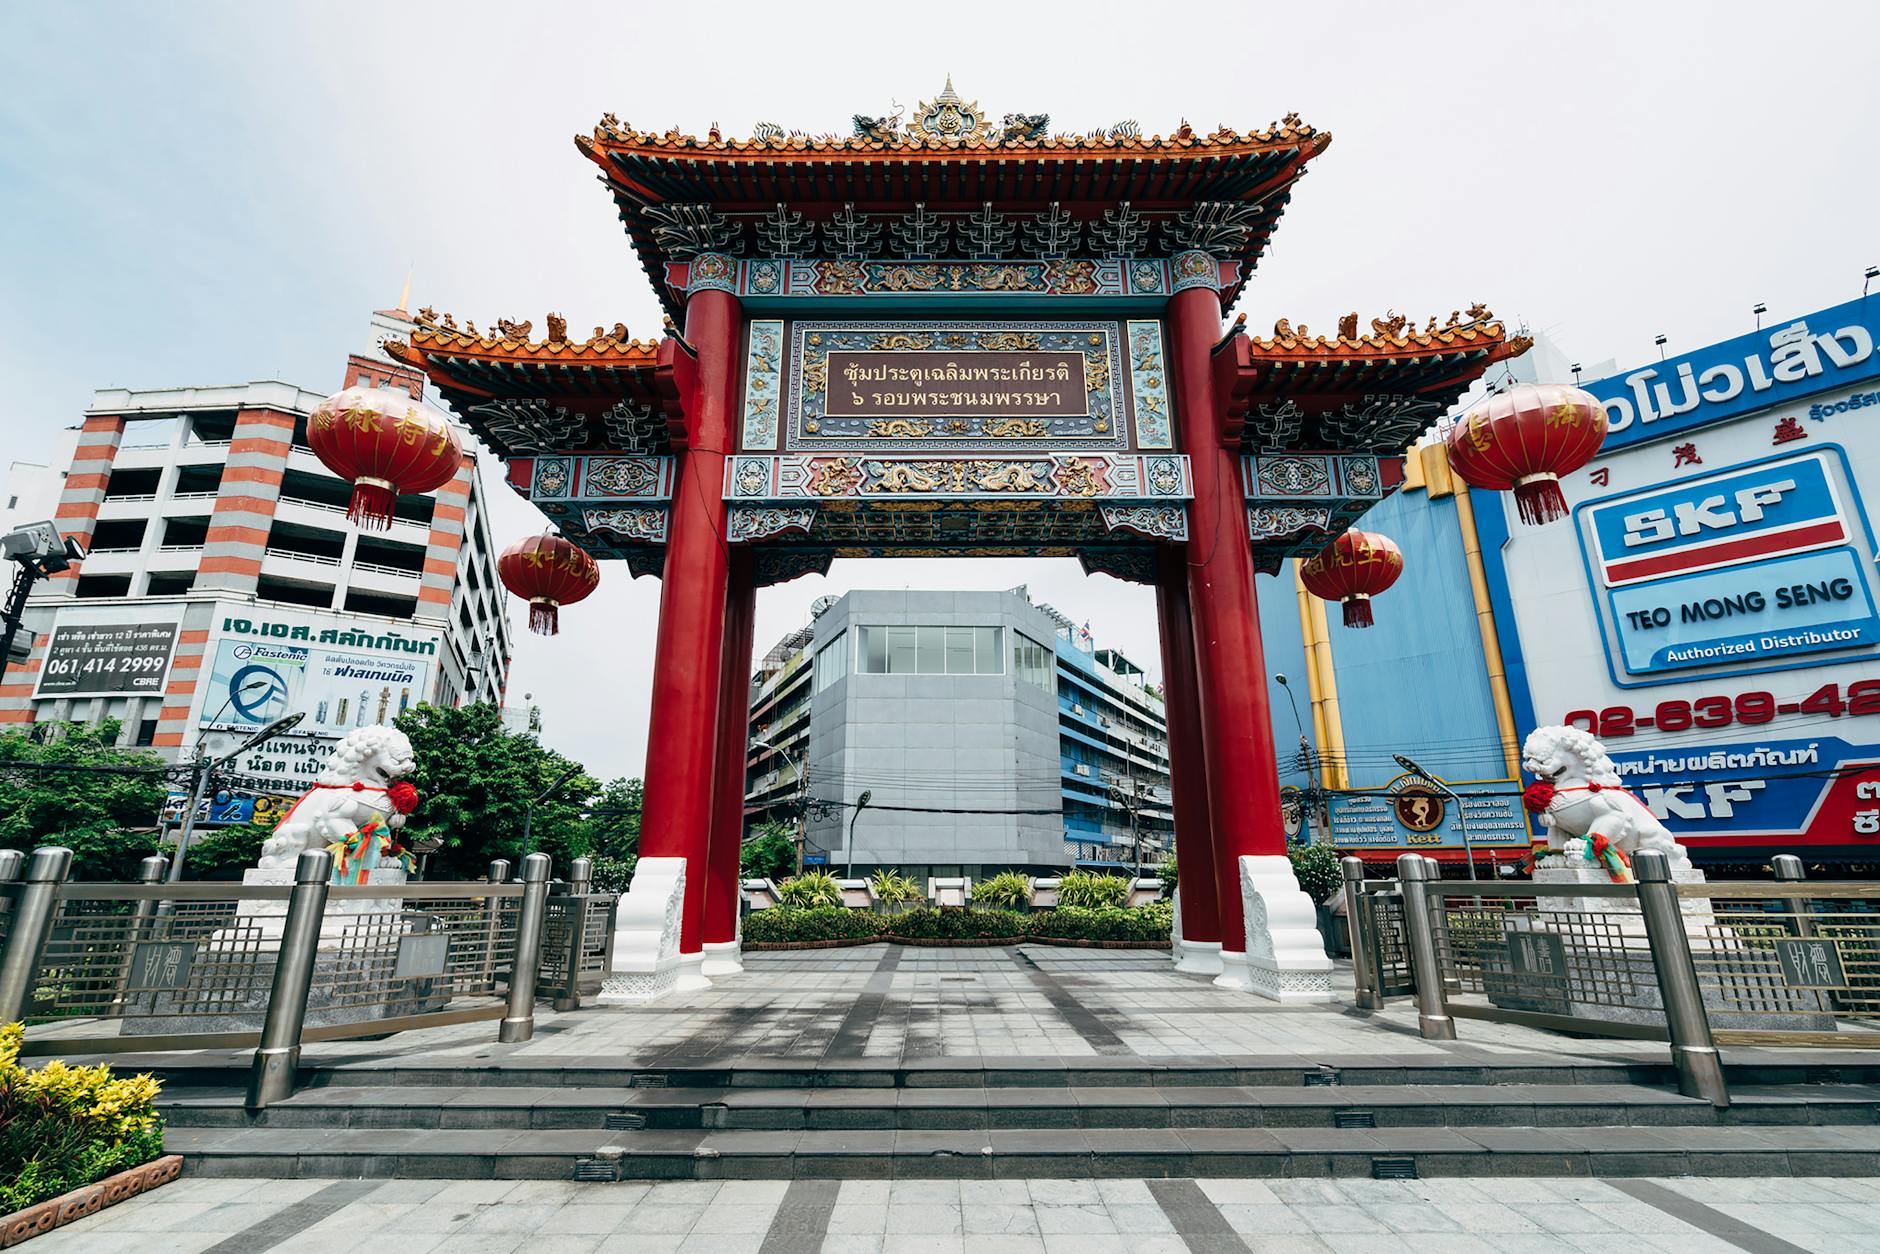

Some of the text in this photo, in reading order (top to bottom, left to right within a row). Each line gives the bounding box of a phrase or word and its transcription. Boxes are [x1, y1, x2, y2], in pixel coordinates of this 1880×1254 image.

[844, 361, 1070, 387] ซุ้มประตูเฉลิมพระเกียรติ
[851, 389, 1061, 407] ๖ รอบพระชนมพรรษา
[1624, 480, 1796, 546] SKF
[1626, 578, 1854, 631] TEO MONG SENG
[252, 647, 308, 661] Fastenic
[1667, 627, 1861, 663] Authorized Distributor
[48, 656, 165, 674] 061 414 2999
[133, 677, 160, 686] CBRE
[1641, 780, 1766, 820] KF
[1407, 833, 1441, 844] Kett
